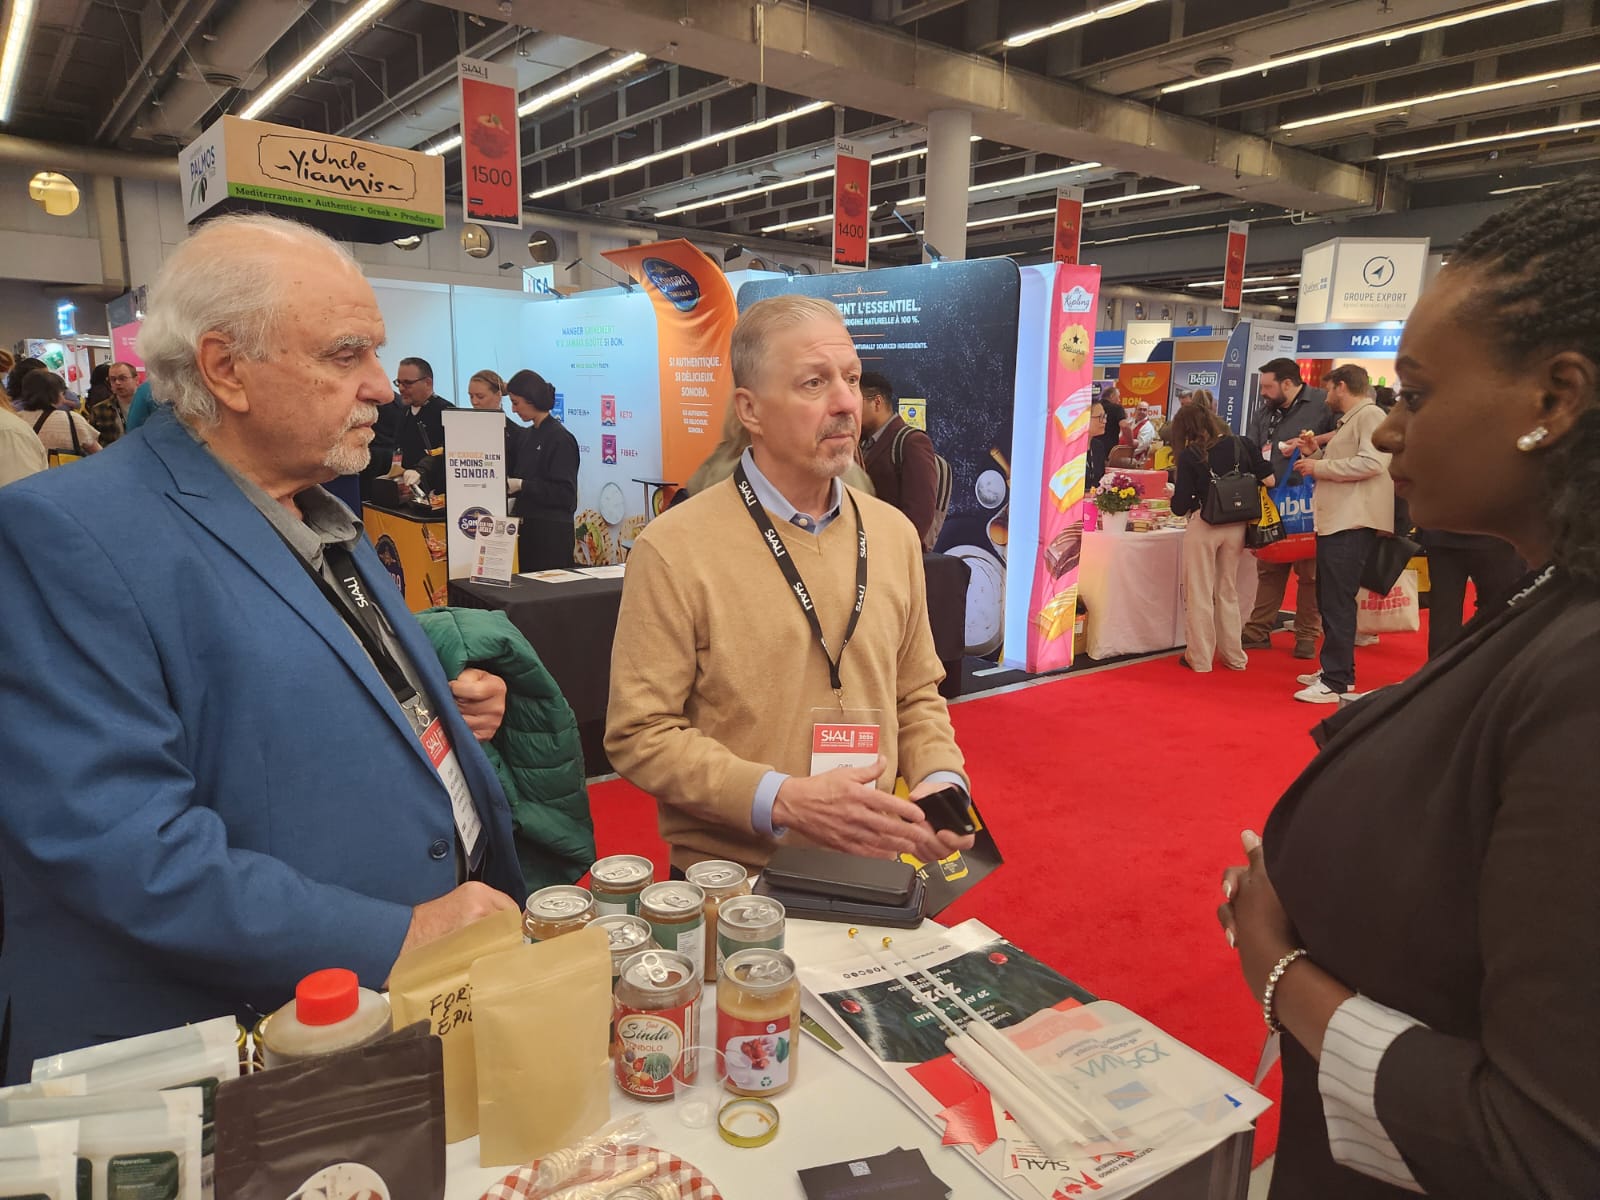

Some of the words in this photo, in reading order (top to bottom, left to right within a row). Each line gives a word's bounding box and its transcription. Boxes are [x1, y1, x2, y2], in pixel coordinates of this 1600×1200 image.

[190, 145, 216, 180] PALMOS
[312, 145, 367, 171] Uncle
[471, 165, 512, 187] 1500
[236, 185, 305, 204] Mediterranean
[315, 198, 358, 213] Authentic
[367, 206, 392, 218] Greek
[400, 211, 436, 225] Products
[838, 223, 865, 239] 1400
[1344, 292, 1375, 302] GROUPE
[1376, 292, 1408, 302] EXPORT
[858, 299, 921, 314] L'ESSENTIEL.
[864, 316, 895, 326] NATURELLE
[1129, 337, 1156, 346] Québec
[1352, 336, 1379, 346] MAP
[450, 459, 458, 467] DE
[460, 459, 483, 467] MOINS
[821, 729, 851, 742] SIAL
[977, 989, 990, 1000] 29
[913, 1011, 935, 1022] MAI
[622, 1023, 669, 1041] Sinda
[1019, 1158, 1070, 1172] SIAL
